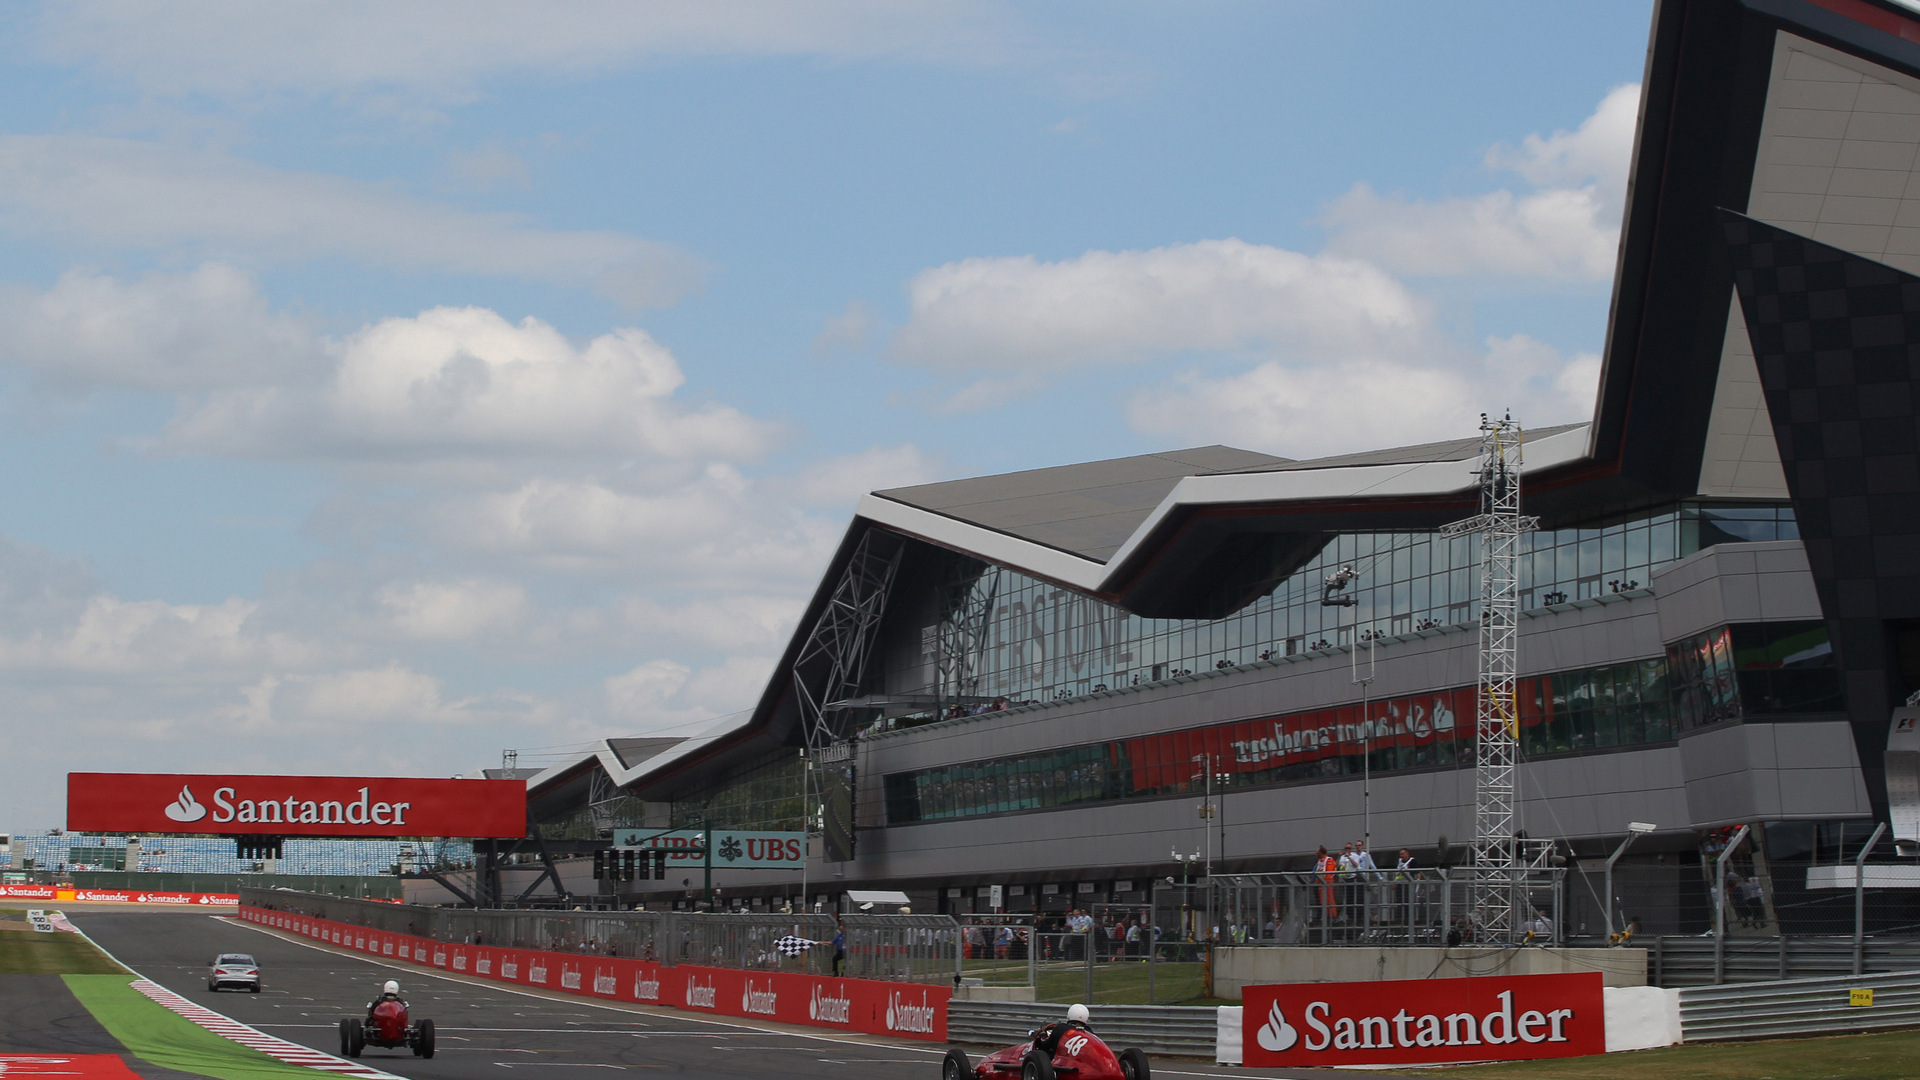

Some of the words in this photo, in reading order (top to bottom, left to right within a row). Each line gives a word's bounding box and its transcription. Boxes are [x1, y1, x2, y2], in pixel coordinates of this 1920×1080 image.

[212, 786, 411, 826] Santander
[746, 838, 801, 861] UBS
[7, 886, 53, 897] Santander
[86, 892, 130, 902] Santander
[147, 894, 191, 904] Santander
[691, 974, 716, 1008] Santander
[749, 978, 777, 1015] Santander
[817, 983, 850, 1024] Santander
[895, 989, 935, 1034] Santander
[1305, 990, 1572, 1051] Santander
[1064, 1035, 1088, 1057] 48
